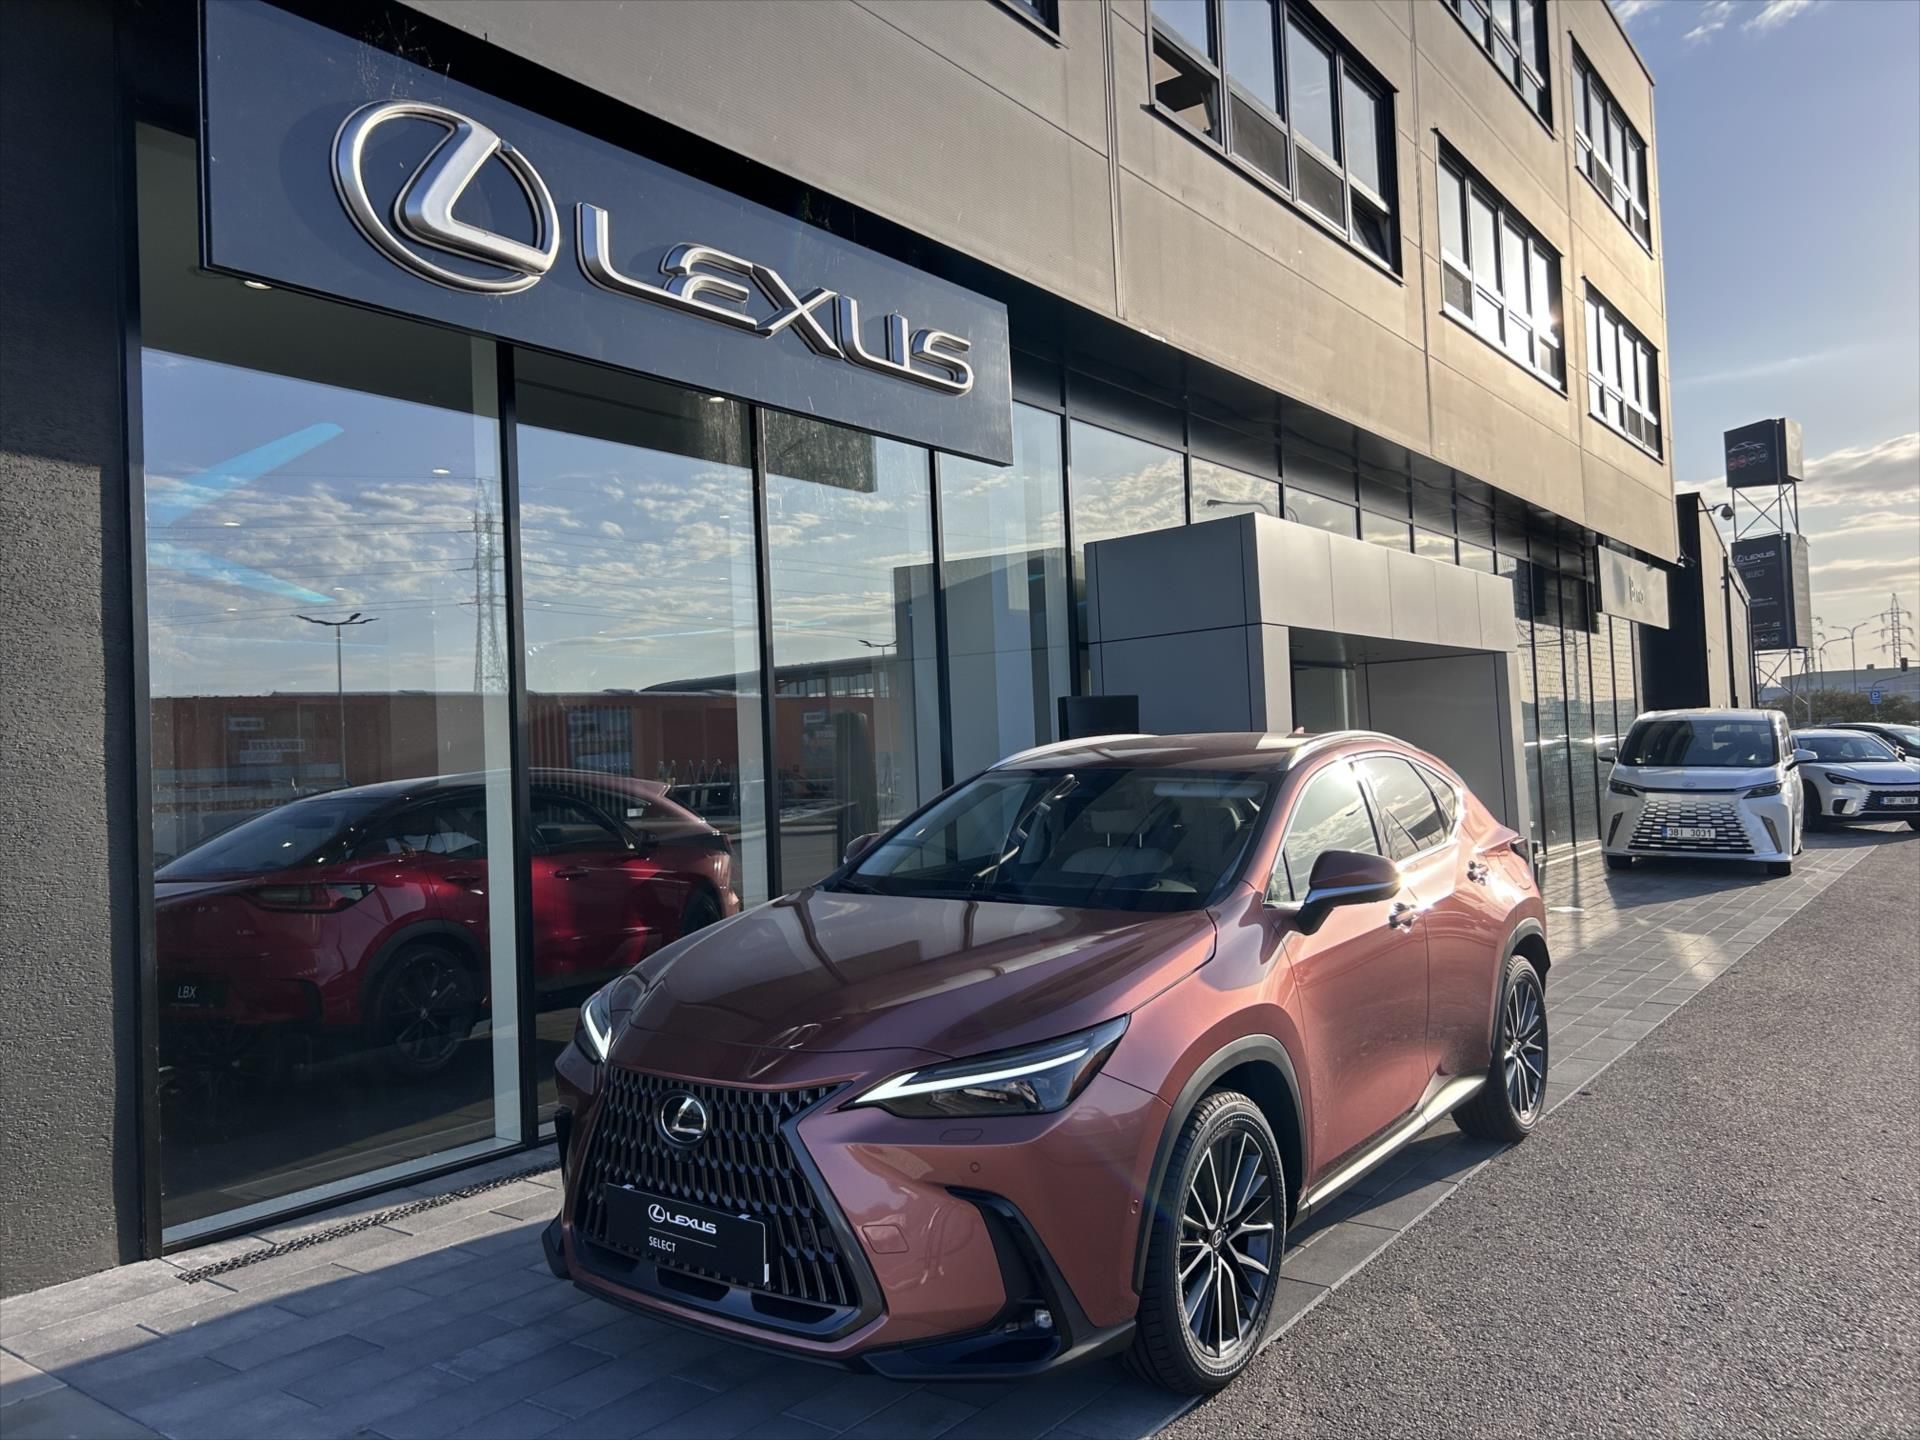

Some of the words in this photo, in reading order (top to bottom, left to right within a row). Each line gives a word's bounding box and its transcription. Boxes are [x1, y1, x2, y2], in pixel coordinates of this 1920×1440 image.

[574, 201, 976, 396] LEXUS
[1690, 829, 1711, 837] 3031
[177, 985, 197, 999] LBX
[666, 1211, 717, 1234] LEXUS
[648, 1236, 676, 1253] SELECT
